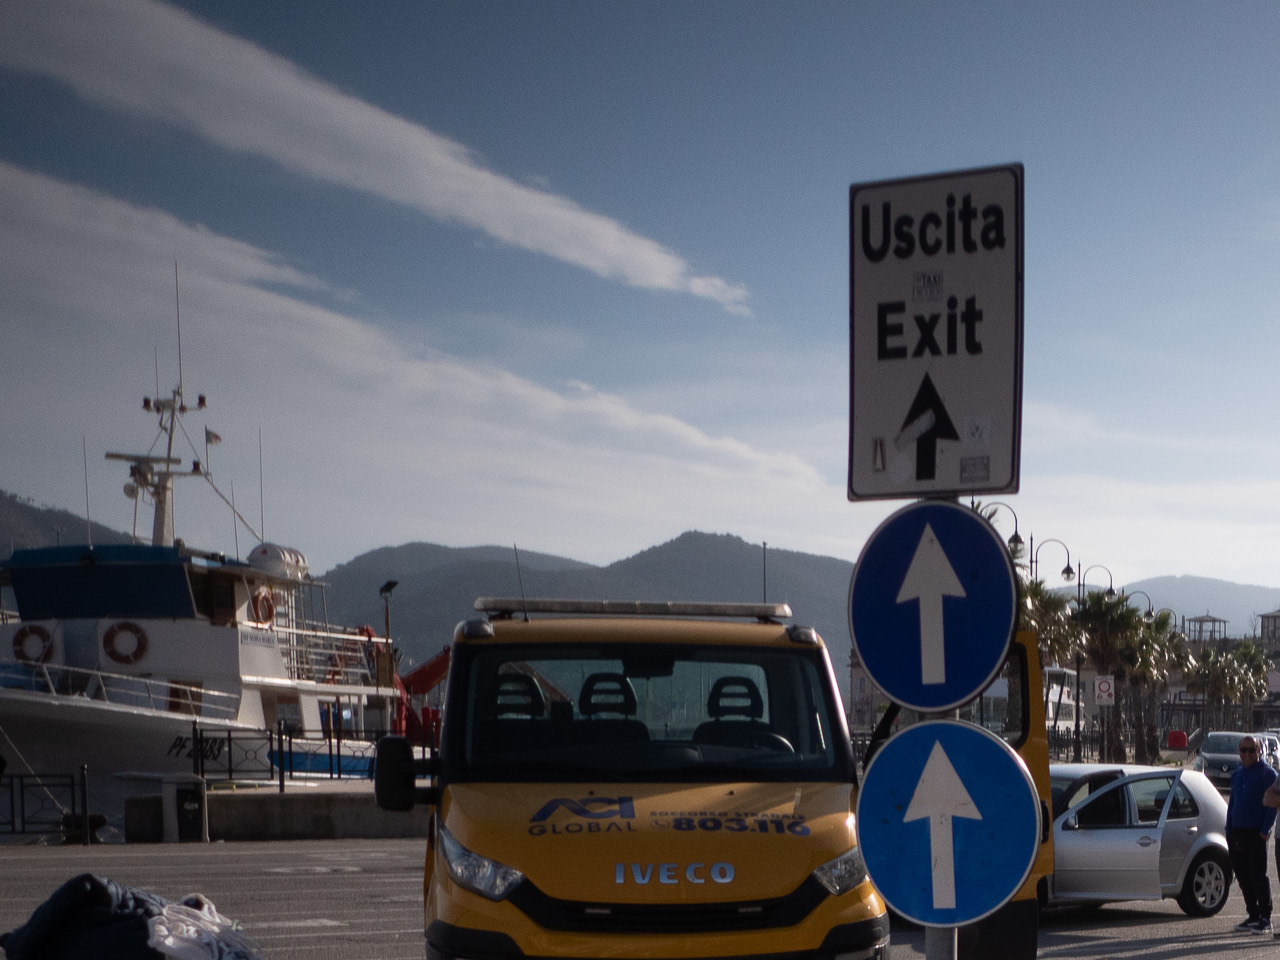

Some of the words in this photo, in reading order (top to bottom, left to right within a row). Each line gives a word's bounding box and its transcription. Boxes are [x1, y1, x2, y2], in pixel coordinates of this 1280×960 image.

[861, 192, 1007, 263] Uscita
[877, 295, 984, 361] Exit
[166, 736, 192, 757] PF
[529, 796, 636, 823] ACI
[528, 821, 638, 837] GLOBAL
[672, 817, 812, 837] 803.116
[614, 861, 736, 885] IVECO
